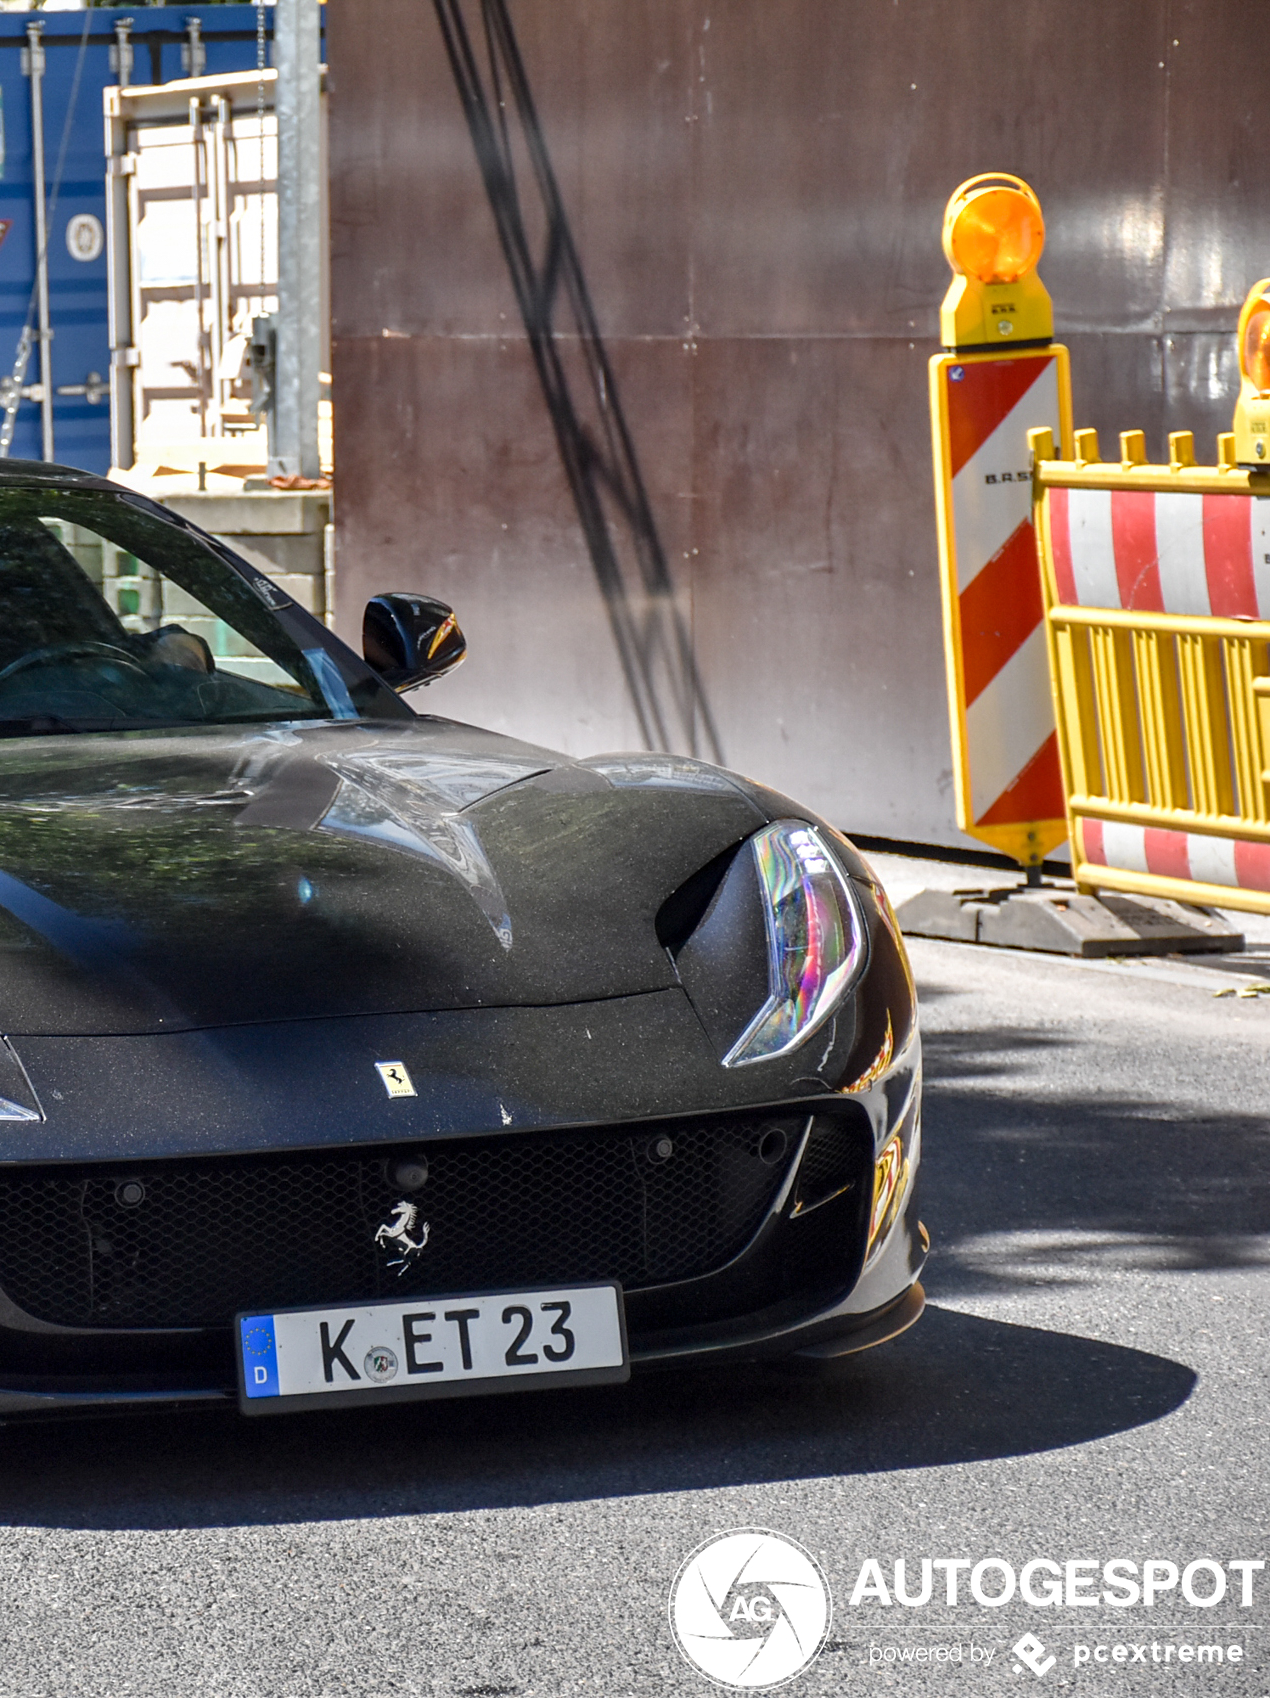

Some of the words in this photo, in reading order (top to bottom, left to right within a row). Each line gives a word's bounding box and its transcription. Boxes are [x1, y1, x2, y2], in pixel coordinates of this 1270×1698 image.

[319, 1319, 362, 1383] K
[402, 1308, 480, 1375] ET
[501, 1300, 576, 1366] 23
[254, 1366, 268, 1385] D
